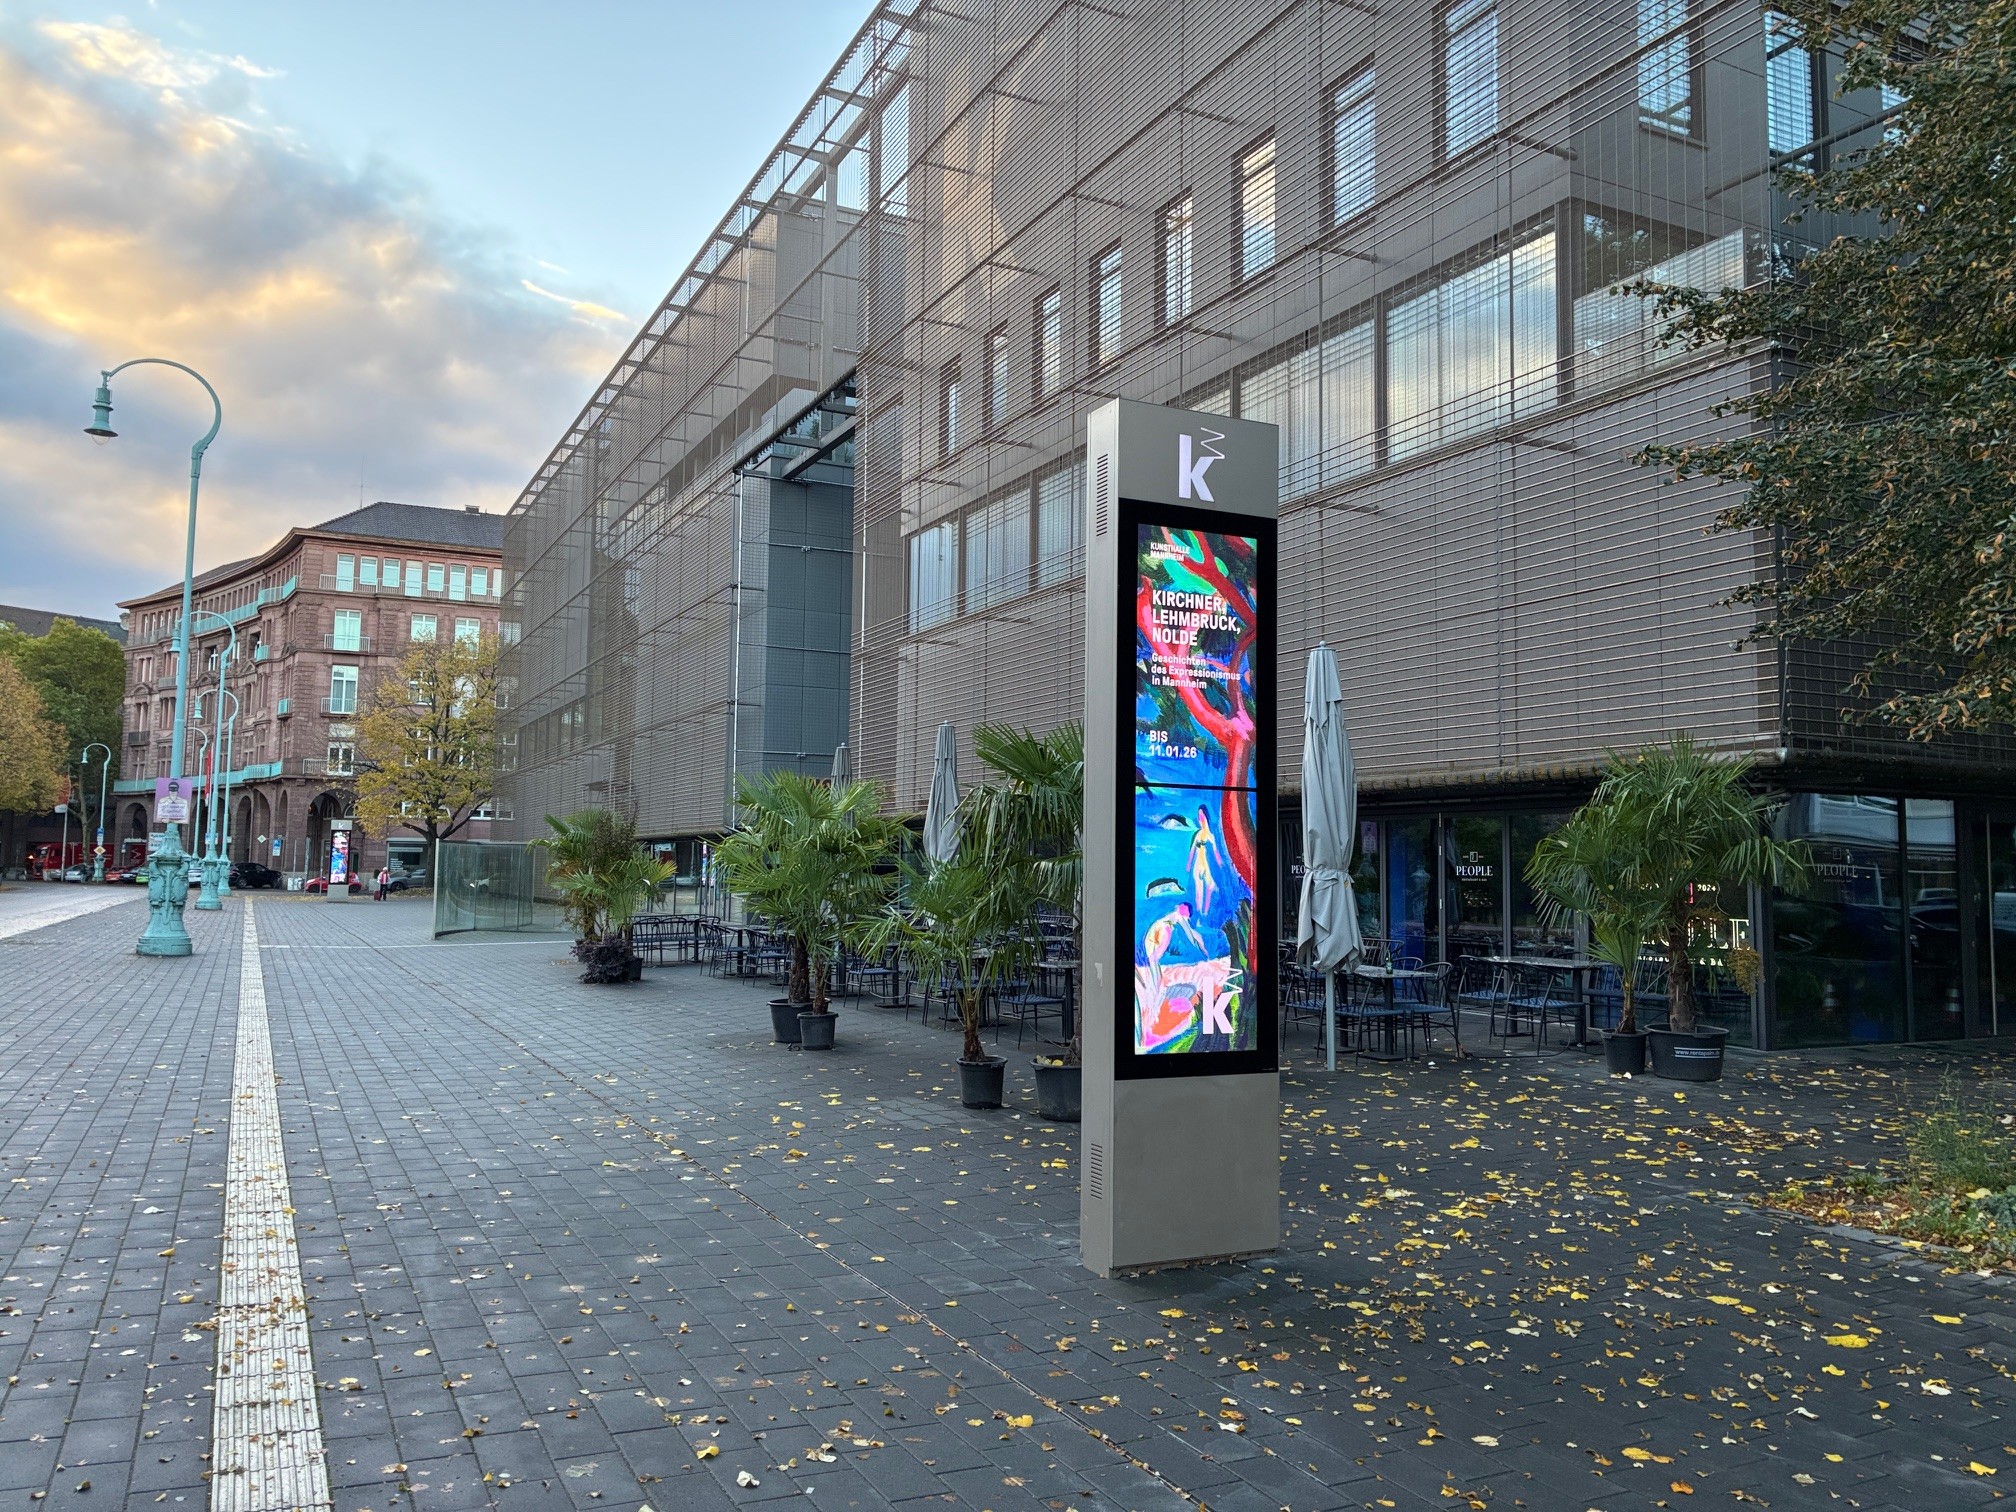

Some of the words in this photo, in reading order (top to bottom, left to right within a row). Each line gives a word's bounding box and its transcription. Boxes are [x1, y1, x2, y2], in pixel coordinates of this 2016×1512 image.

[1150, 542, 1190, 555] KUNSTHALLE
[1150, 550, 1184, 562] MANNHEIM
[1152, 589, 1227, 616] KIRCHNER,
[1152, 608, 1241, 634] LEHMBRUCK,
[1152, 627, 1198, 646] NOLDE
[1152, 652, 1206, 667] Geschichten
[1151, 664, 1167, 674] des
[1168, 665, 1241, 681] Expressionismus
[1152, 675, 1160, 685] in
[1162, 676, 1207, 689] Mannheim
[1149, 730, 1168, 743] BIS
[1148, 744, 1197, 759] 11.01.26
[1456, 865, 1494, 877] PEOPLE
[1816, 864, 1859, 878] PEOPLE
